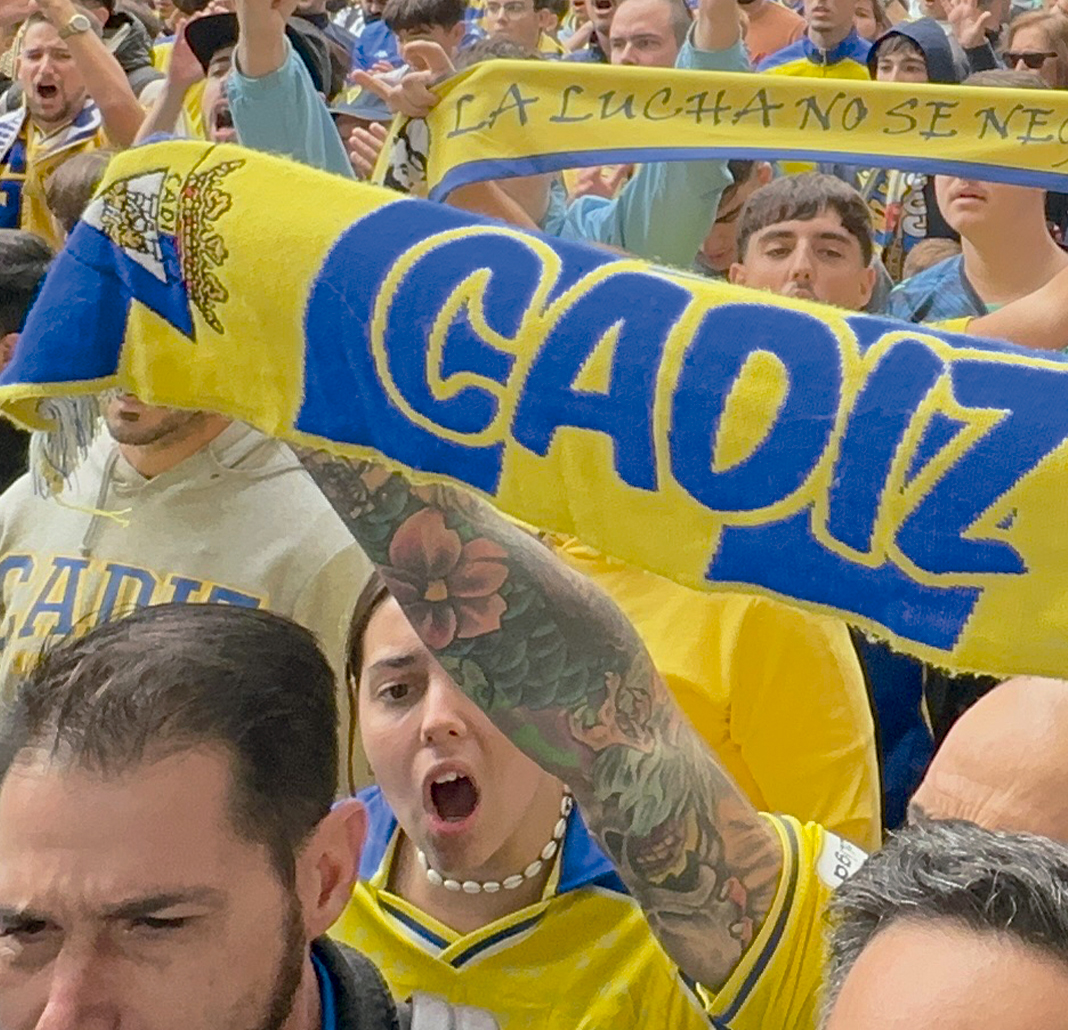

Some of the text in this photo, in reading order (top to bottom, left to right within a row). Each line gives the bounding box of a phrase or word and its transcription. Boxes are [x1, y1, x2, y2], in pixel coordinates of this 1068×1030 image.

[447, 81, 539, 138] LA
[549, 82, 783, 130] LUCHA
[795, 90, 868, 133] NO
[882, 98, 960, 139] SE
